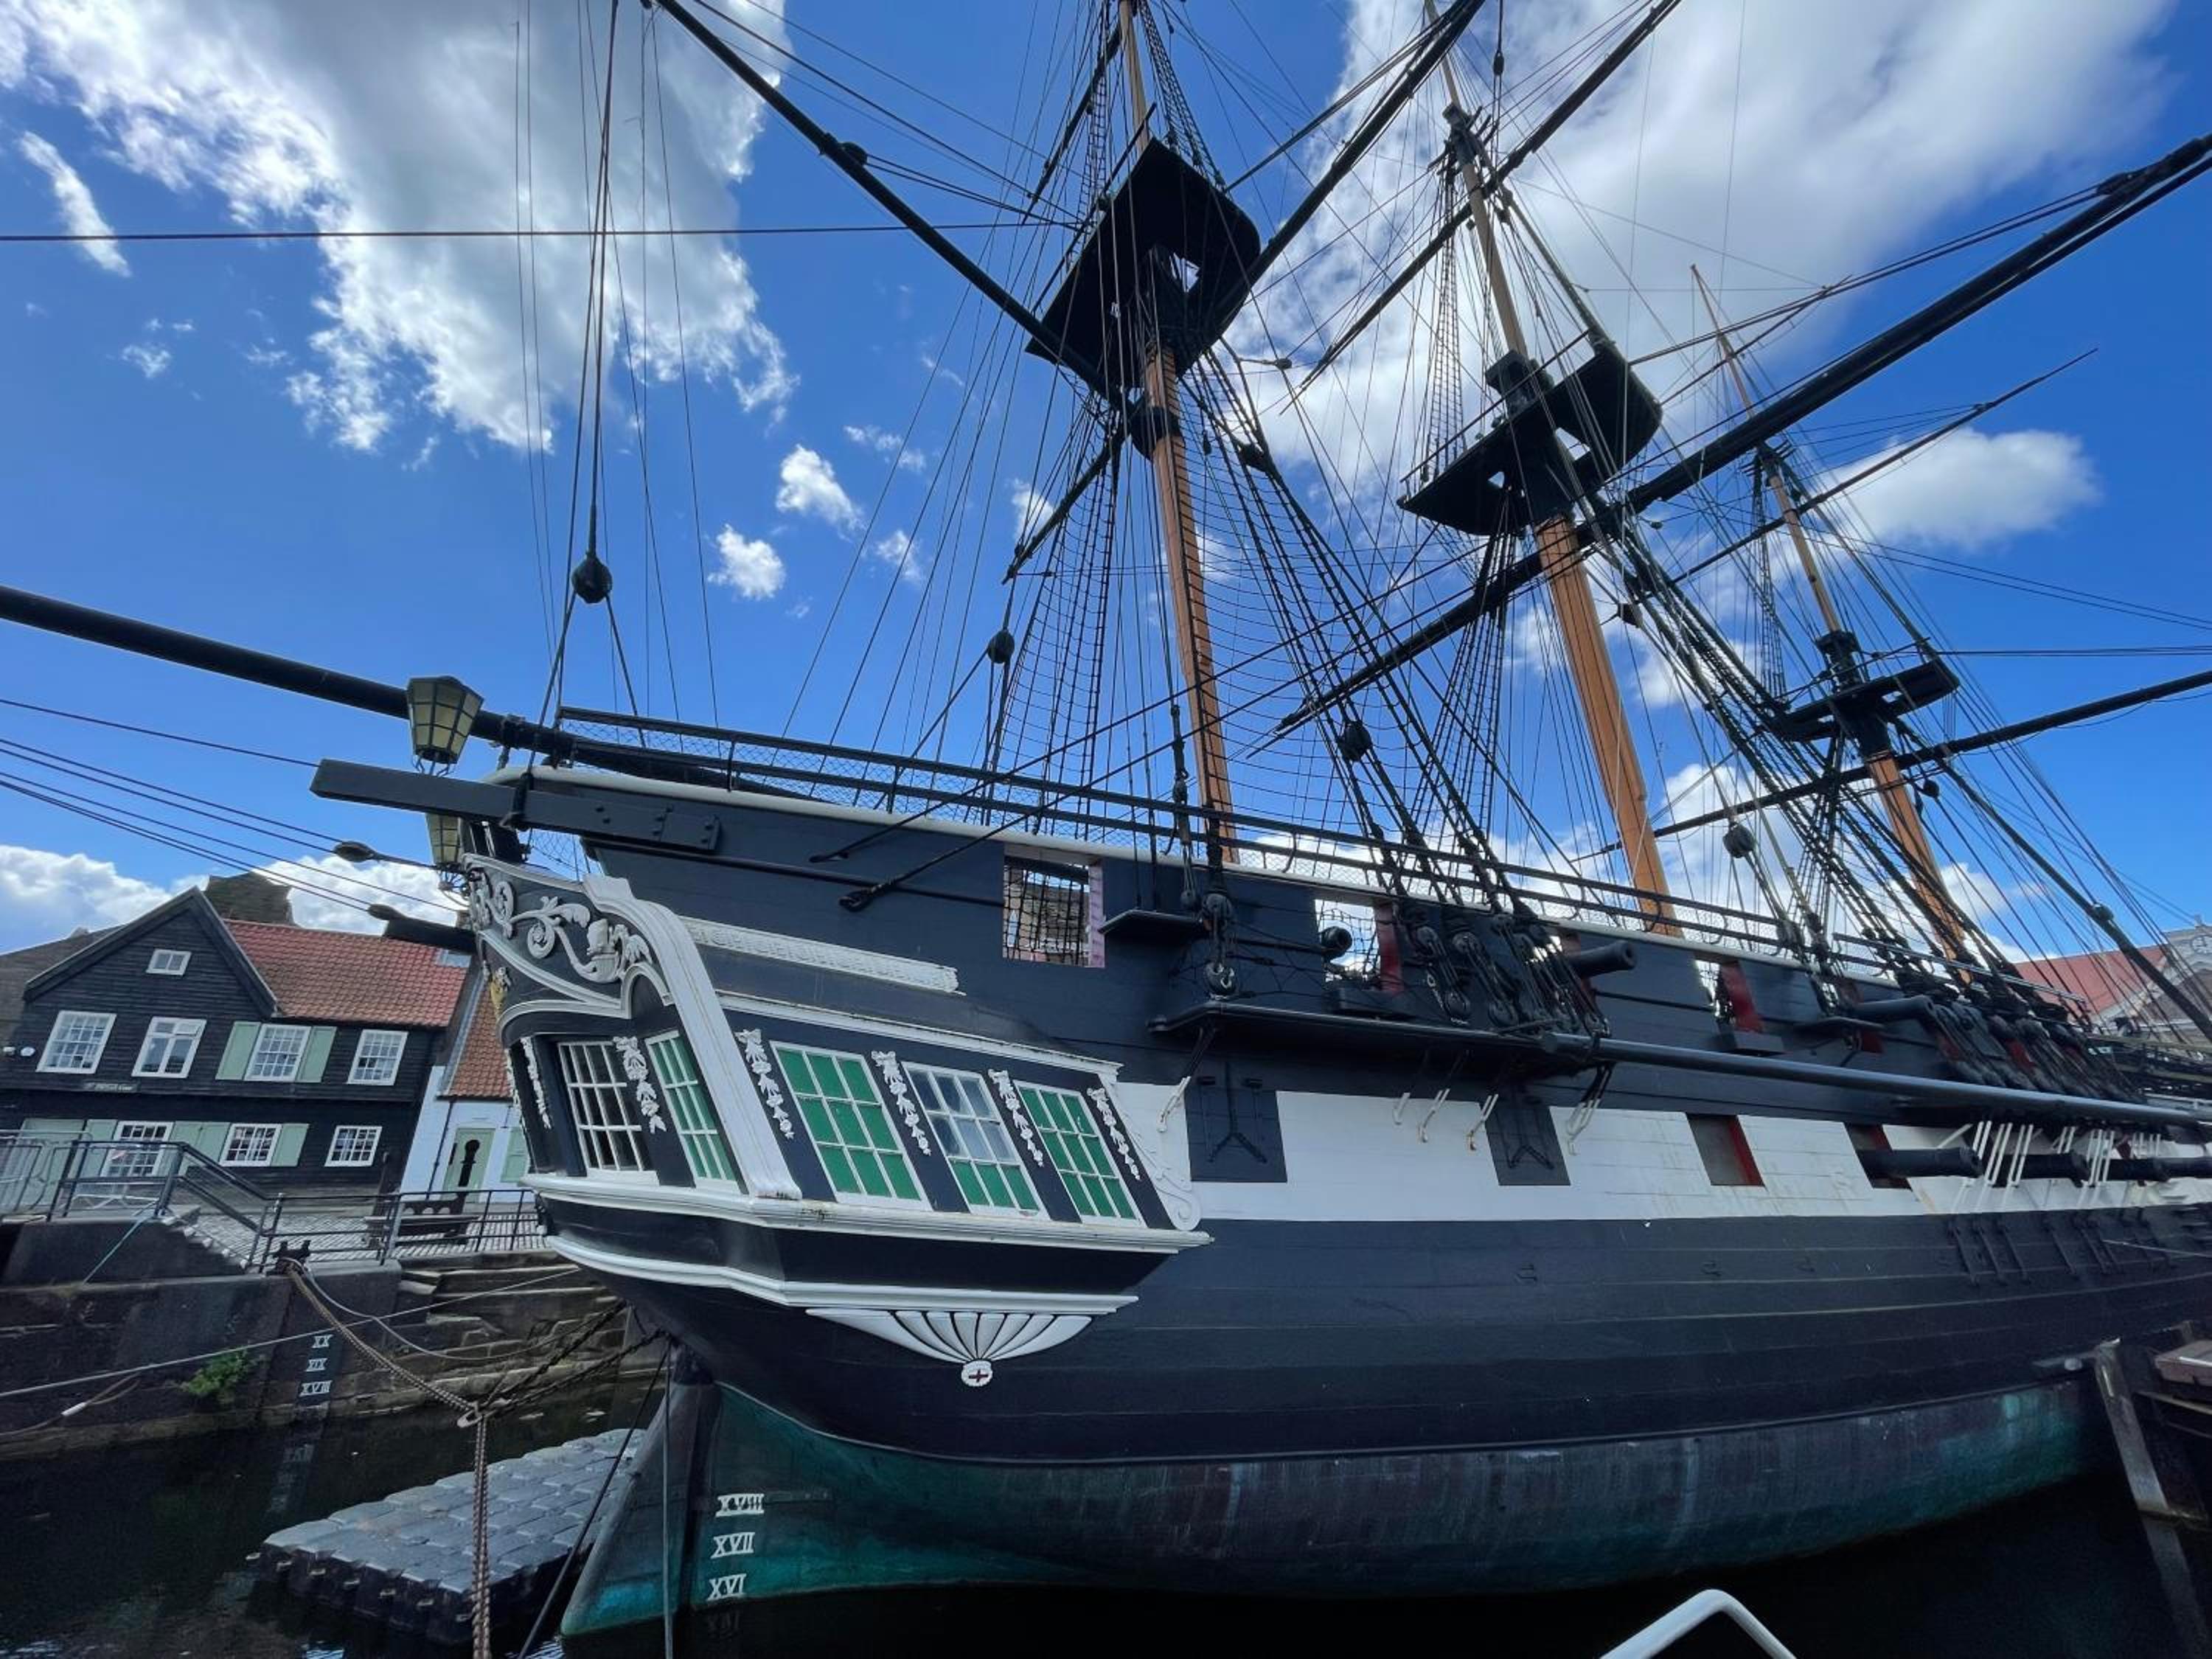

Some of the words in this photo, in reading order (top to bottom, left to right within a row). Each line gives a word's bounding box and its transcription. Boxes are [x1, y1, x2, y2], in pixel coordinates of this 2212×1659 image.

[313, 1335, 333, 1348] XX
[306, 1357, 327, 1371] XIX
[716, 1493, 765, 1517] XVIII
[711, 1531, 755, 1559] XVII
[706, 1573, 747, 1601] XVI
